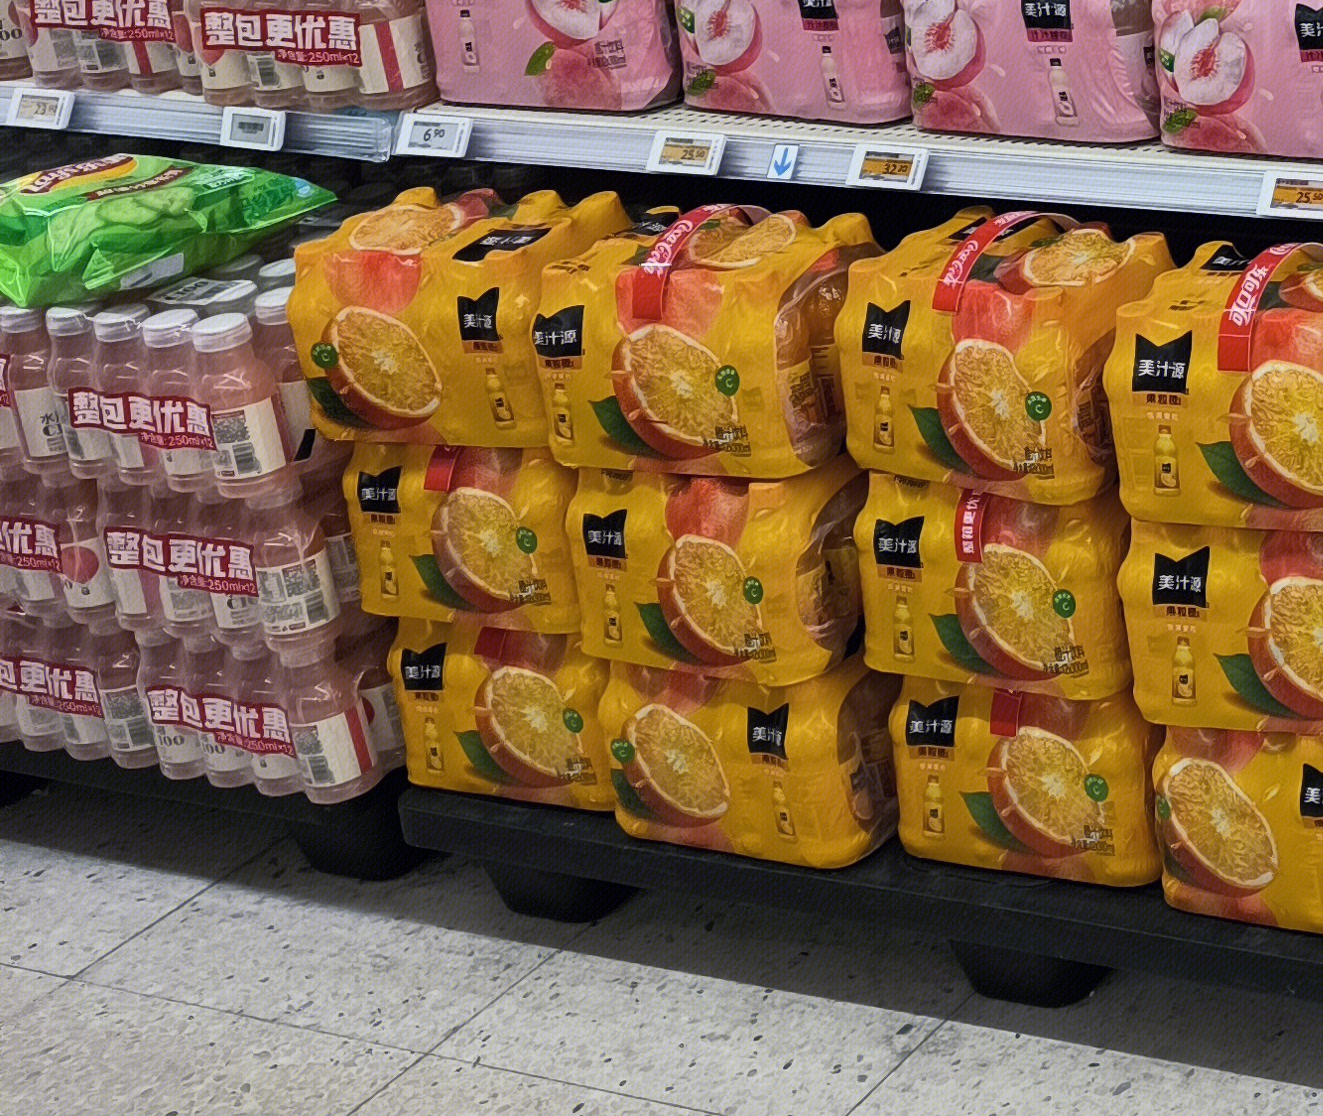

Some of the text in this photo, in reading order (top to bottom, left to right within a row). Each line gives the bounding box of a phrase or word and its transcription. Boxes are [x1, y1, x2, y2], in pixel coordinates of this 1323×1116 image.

[204, 10, 357, 51] 整包更优惠
[1230, 263, 1270, 327] 可口可乐
[1138, 358, 1186, 379] 美汁源
[73, 392, 211, 435] 整包更优惠
[107, 531, 255, 581] 整包更优惠
[1157, 574, 1204, 592] 美汁源
[149, 688, 290, 744] 整包更优惠
[908, 717, 953, 735] 美汁源
